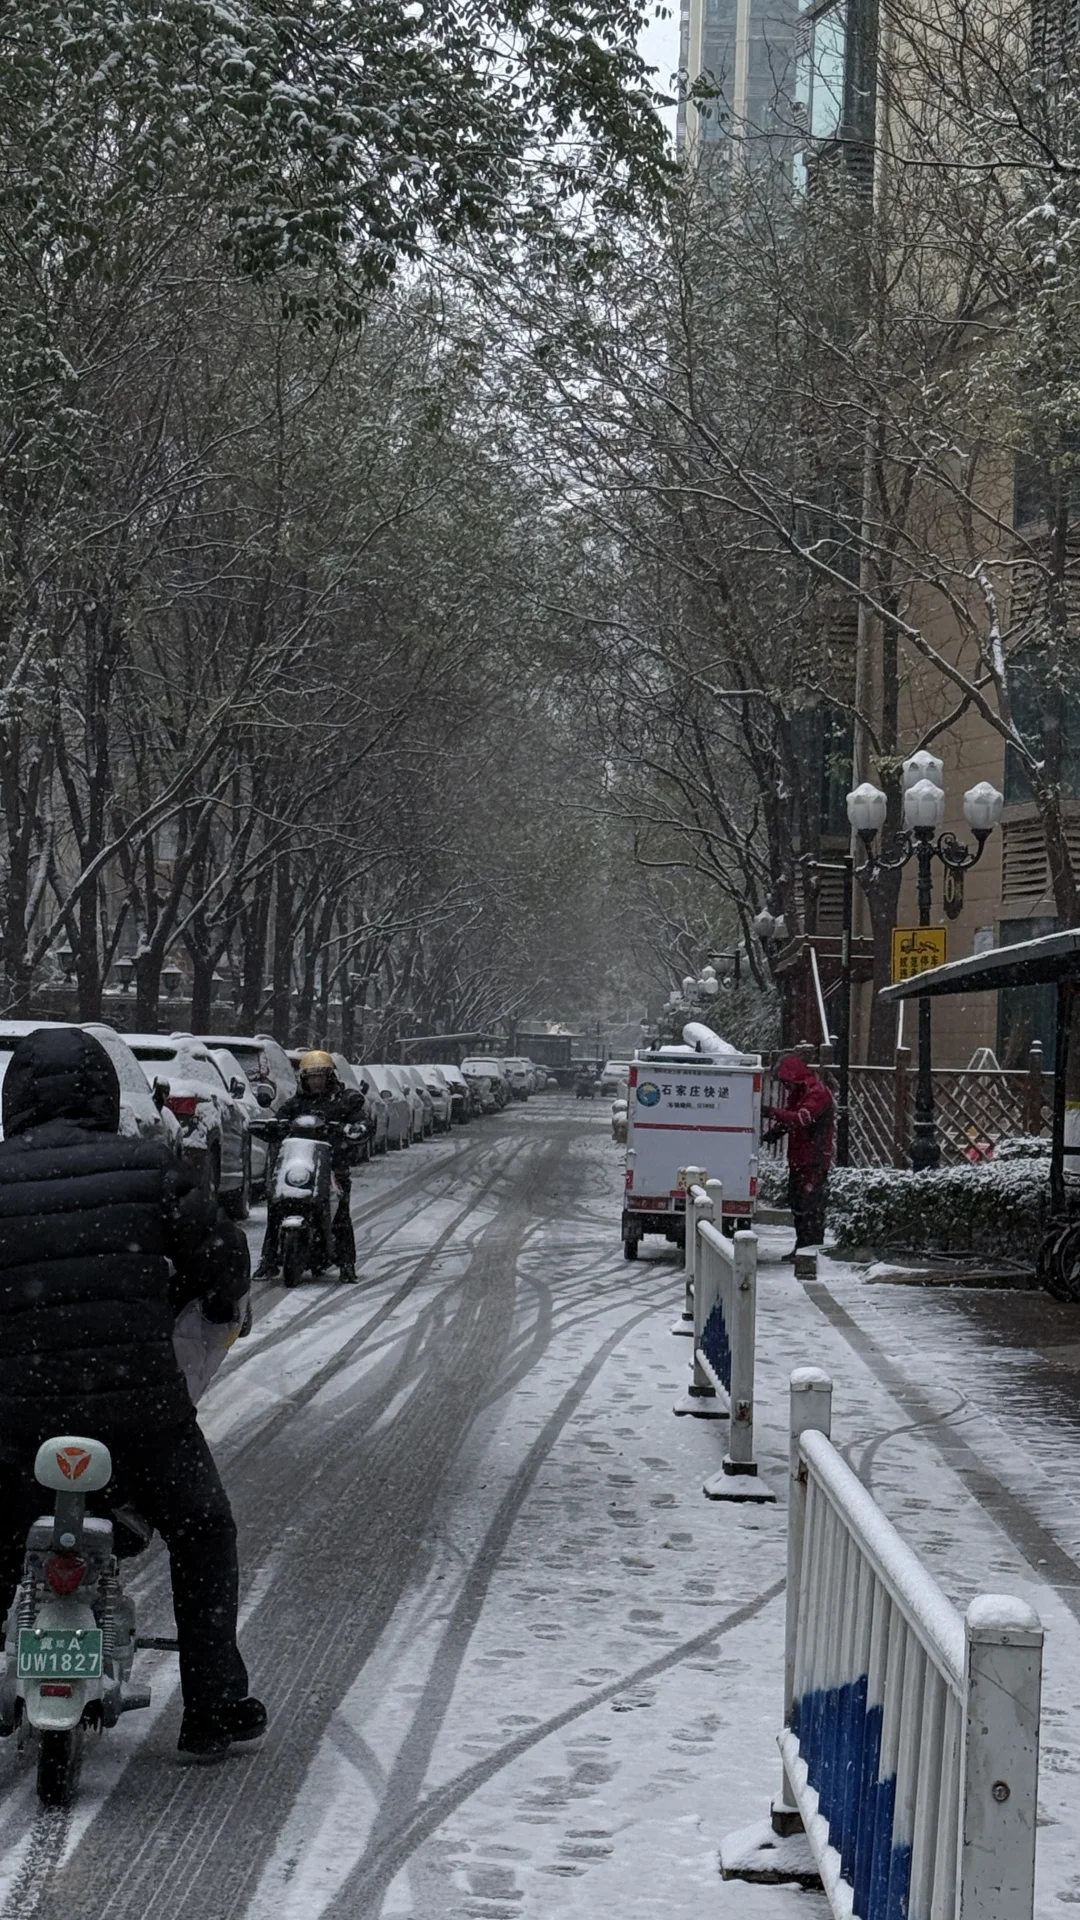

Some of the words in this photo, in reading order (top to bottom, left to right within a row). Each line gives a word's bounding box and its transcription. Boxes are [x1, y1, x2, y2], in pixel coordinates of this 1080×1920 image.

[661, 1084, 730, 1099] 石家庄快递
[20, 1652, 99, 1672] UW1827
